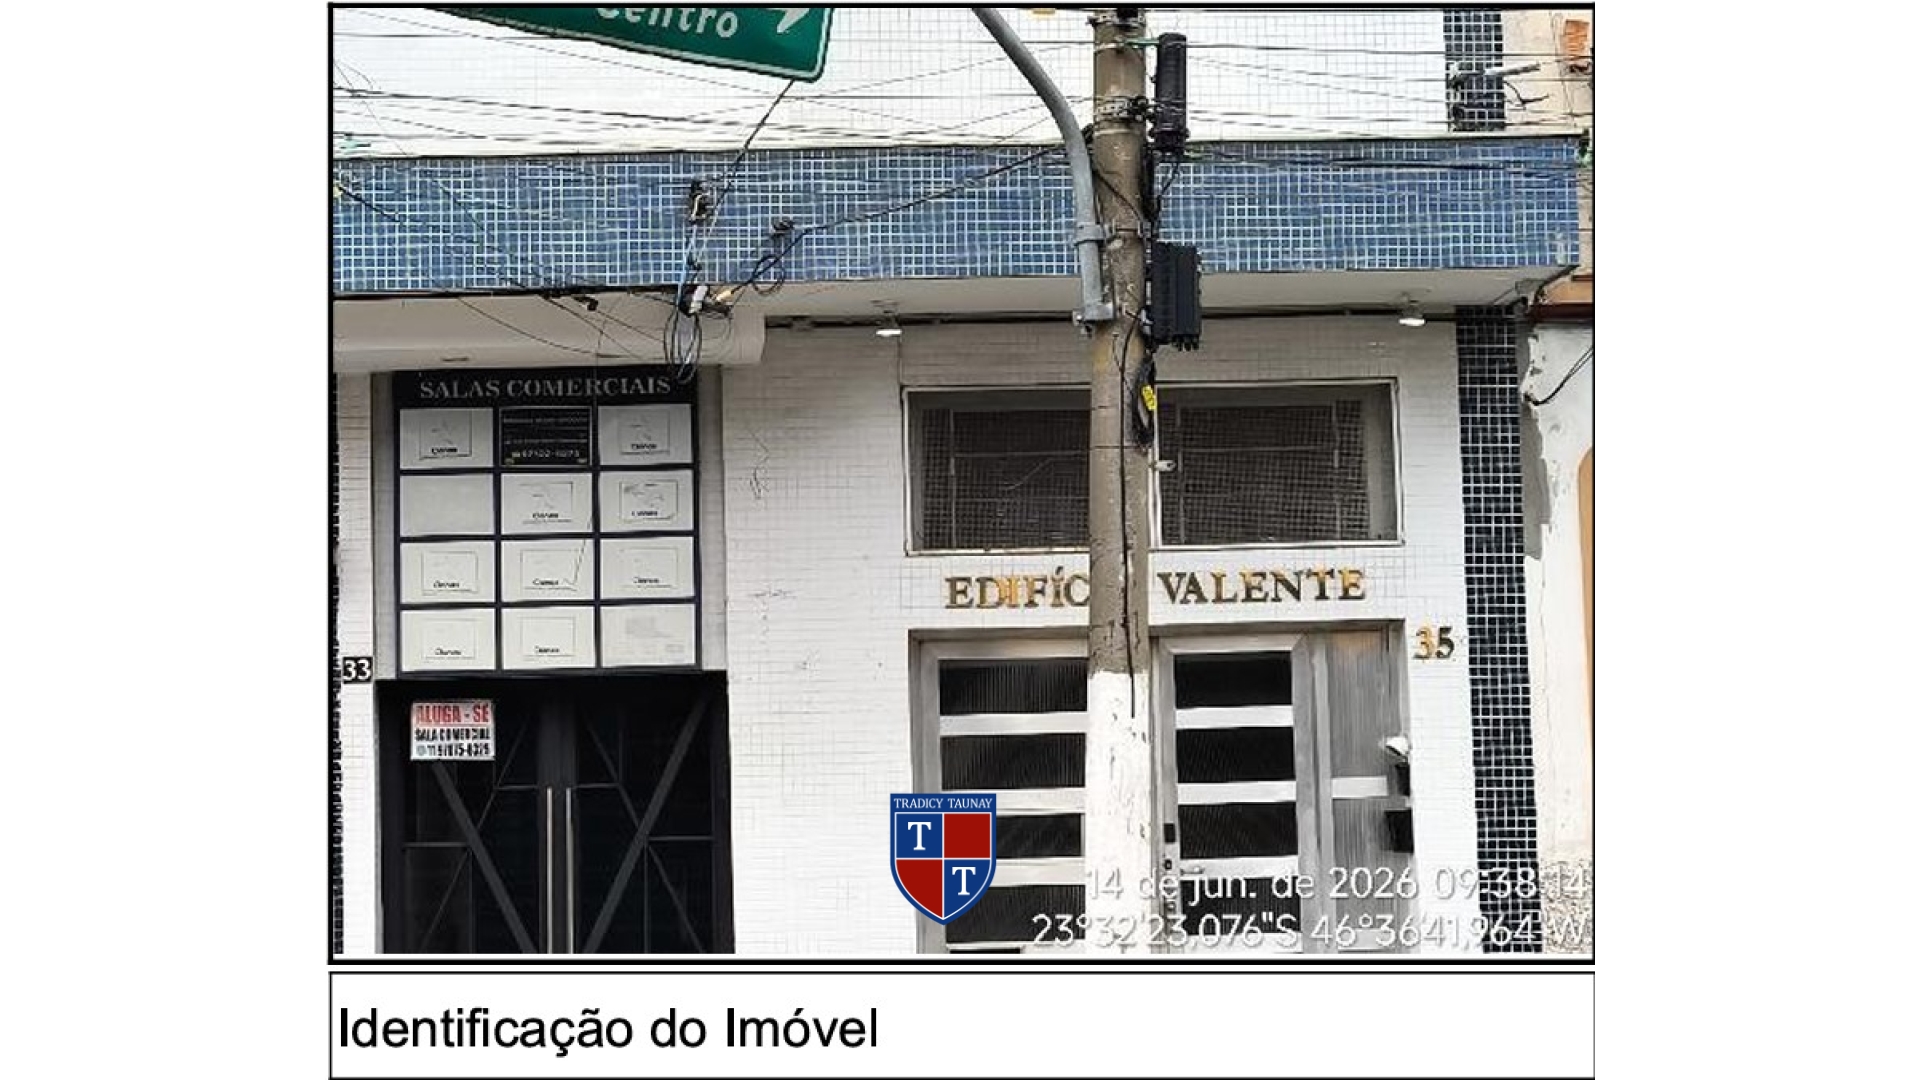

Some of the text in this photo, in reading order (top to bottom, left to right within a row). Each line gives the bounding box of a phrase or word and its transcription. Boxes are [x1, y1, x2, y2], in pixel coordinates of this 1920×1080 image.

[420, 376, 672, 399] SALAS COMERCIAIS
[944, 566, 1366, 609] EDIFÍC VALENTE
[1413, 626, 1455, 659] 35
[342, 659, 371, 681] 33
[415, 705, 461, 723] ALUGA
[473, 703, 489, 723] SE
